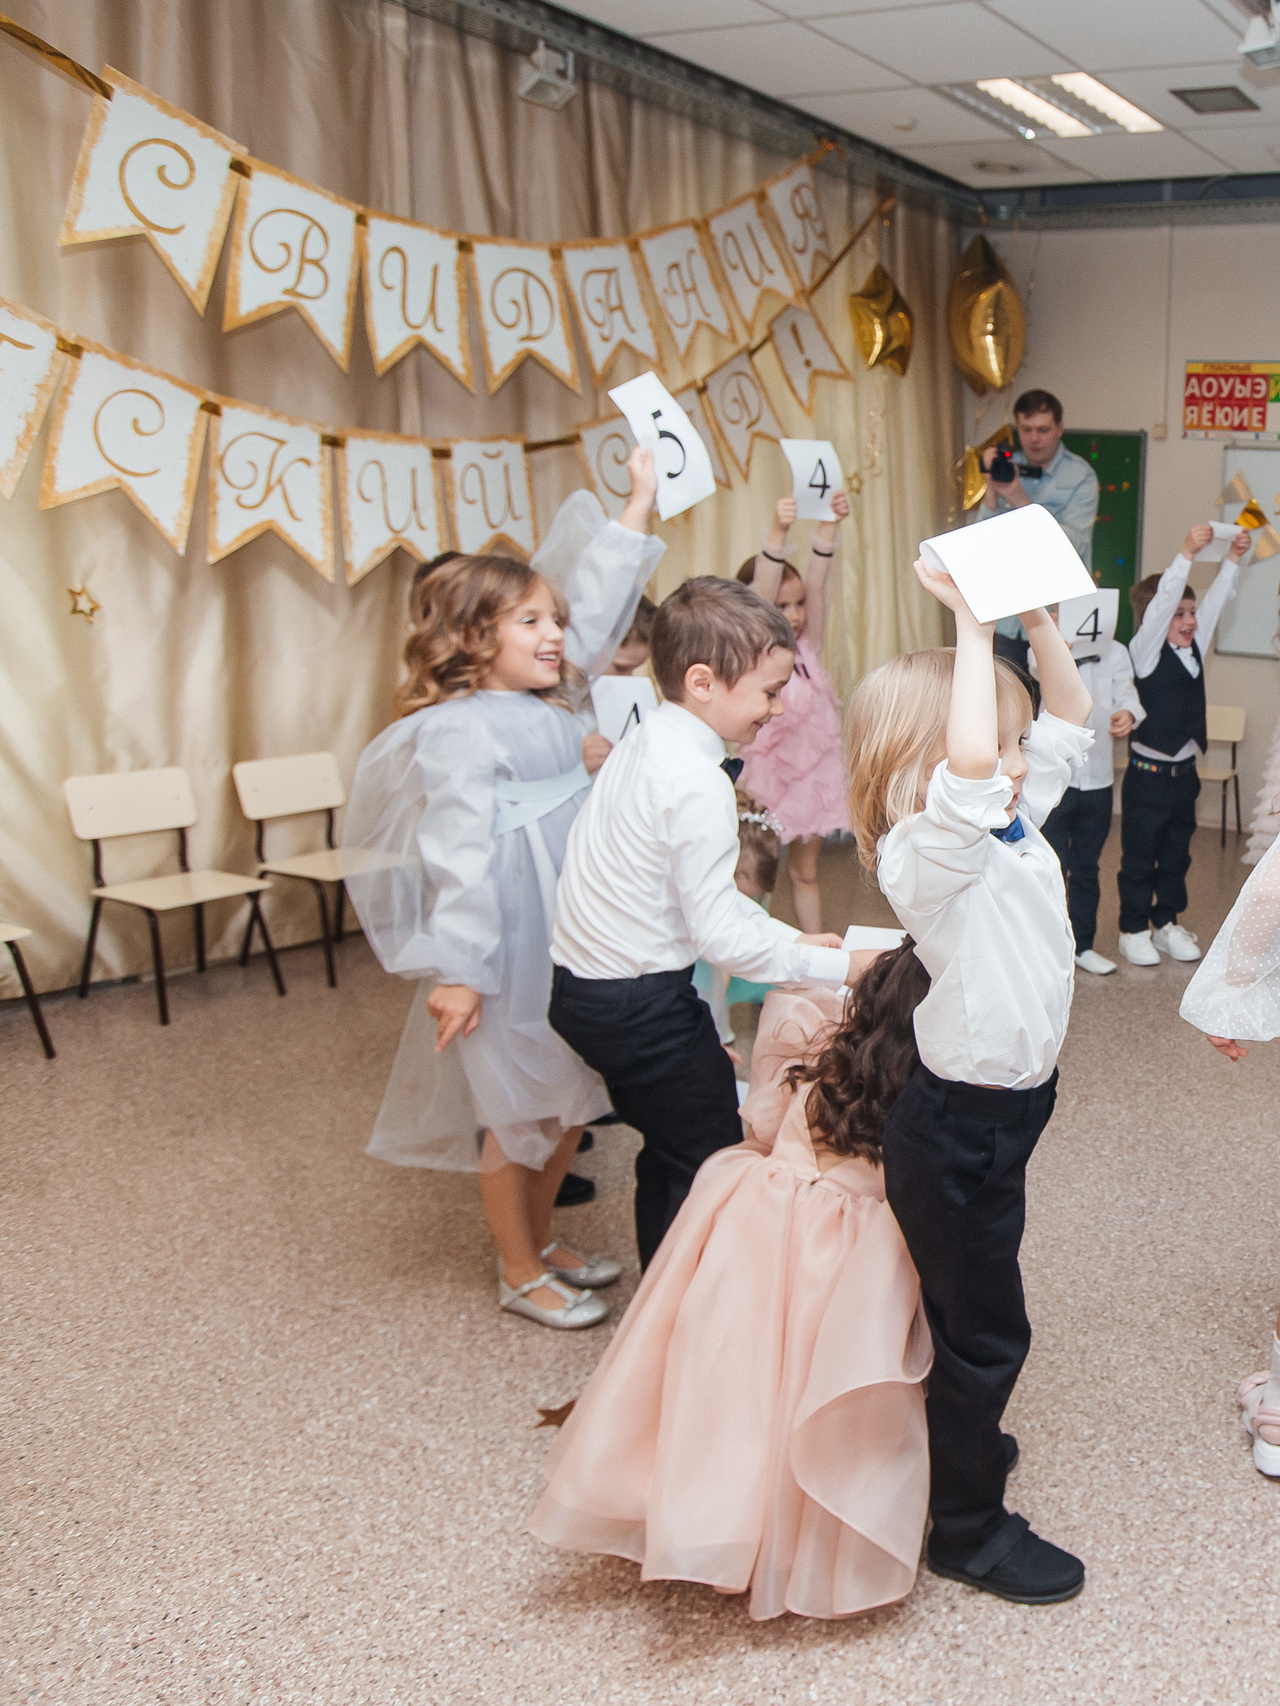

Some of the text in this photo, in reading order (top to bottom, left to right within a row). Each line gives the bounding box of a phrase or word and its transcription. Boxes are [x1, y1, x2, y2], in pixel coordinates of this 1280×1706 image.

[0, 331, 524, 533] СКИЙ
[651, 409, 686, 479] 5
[808, 458, 831, 499] 4
[1076, 607, 1102, 642] 4
